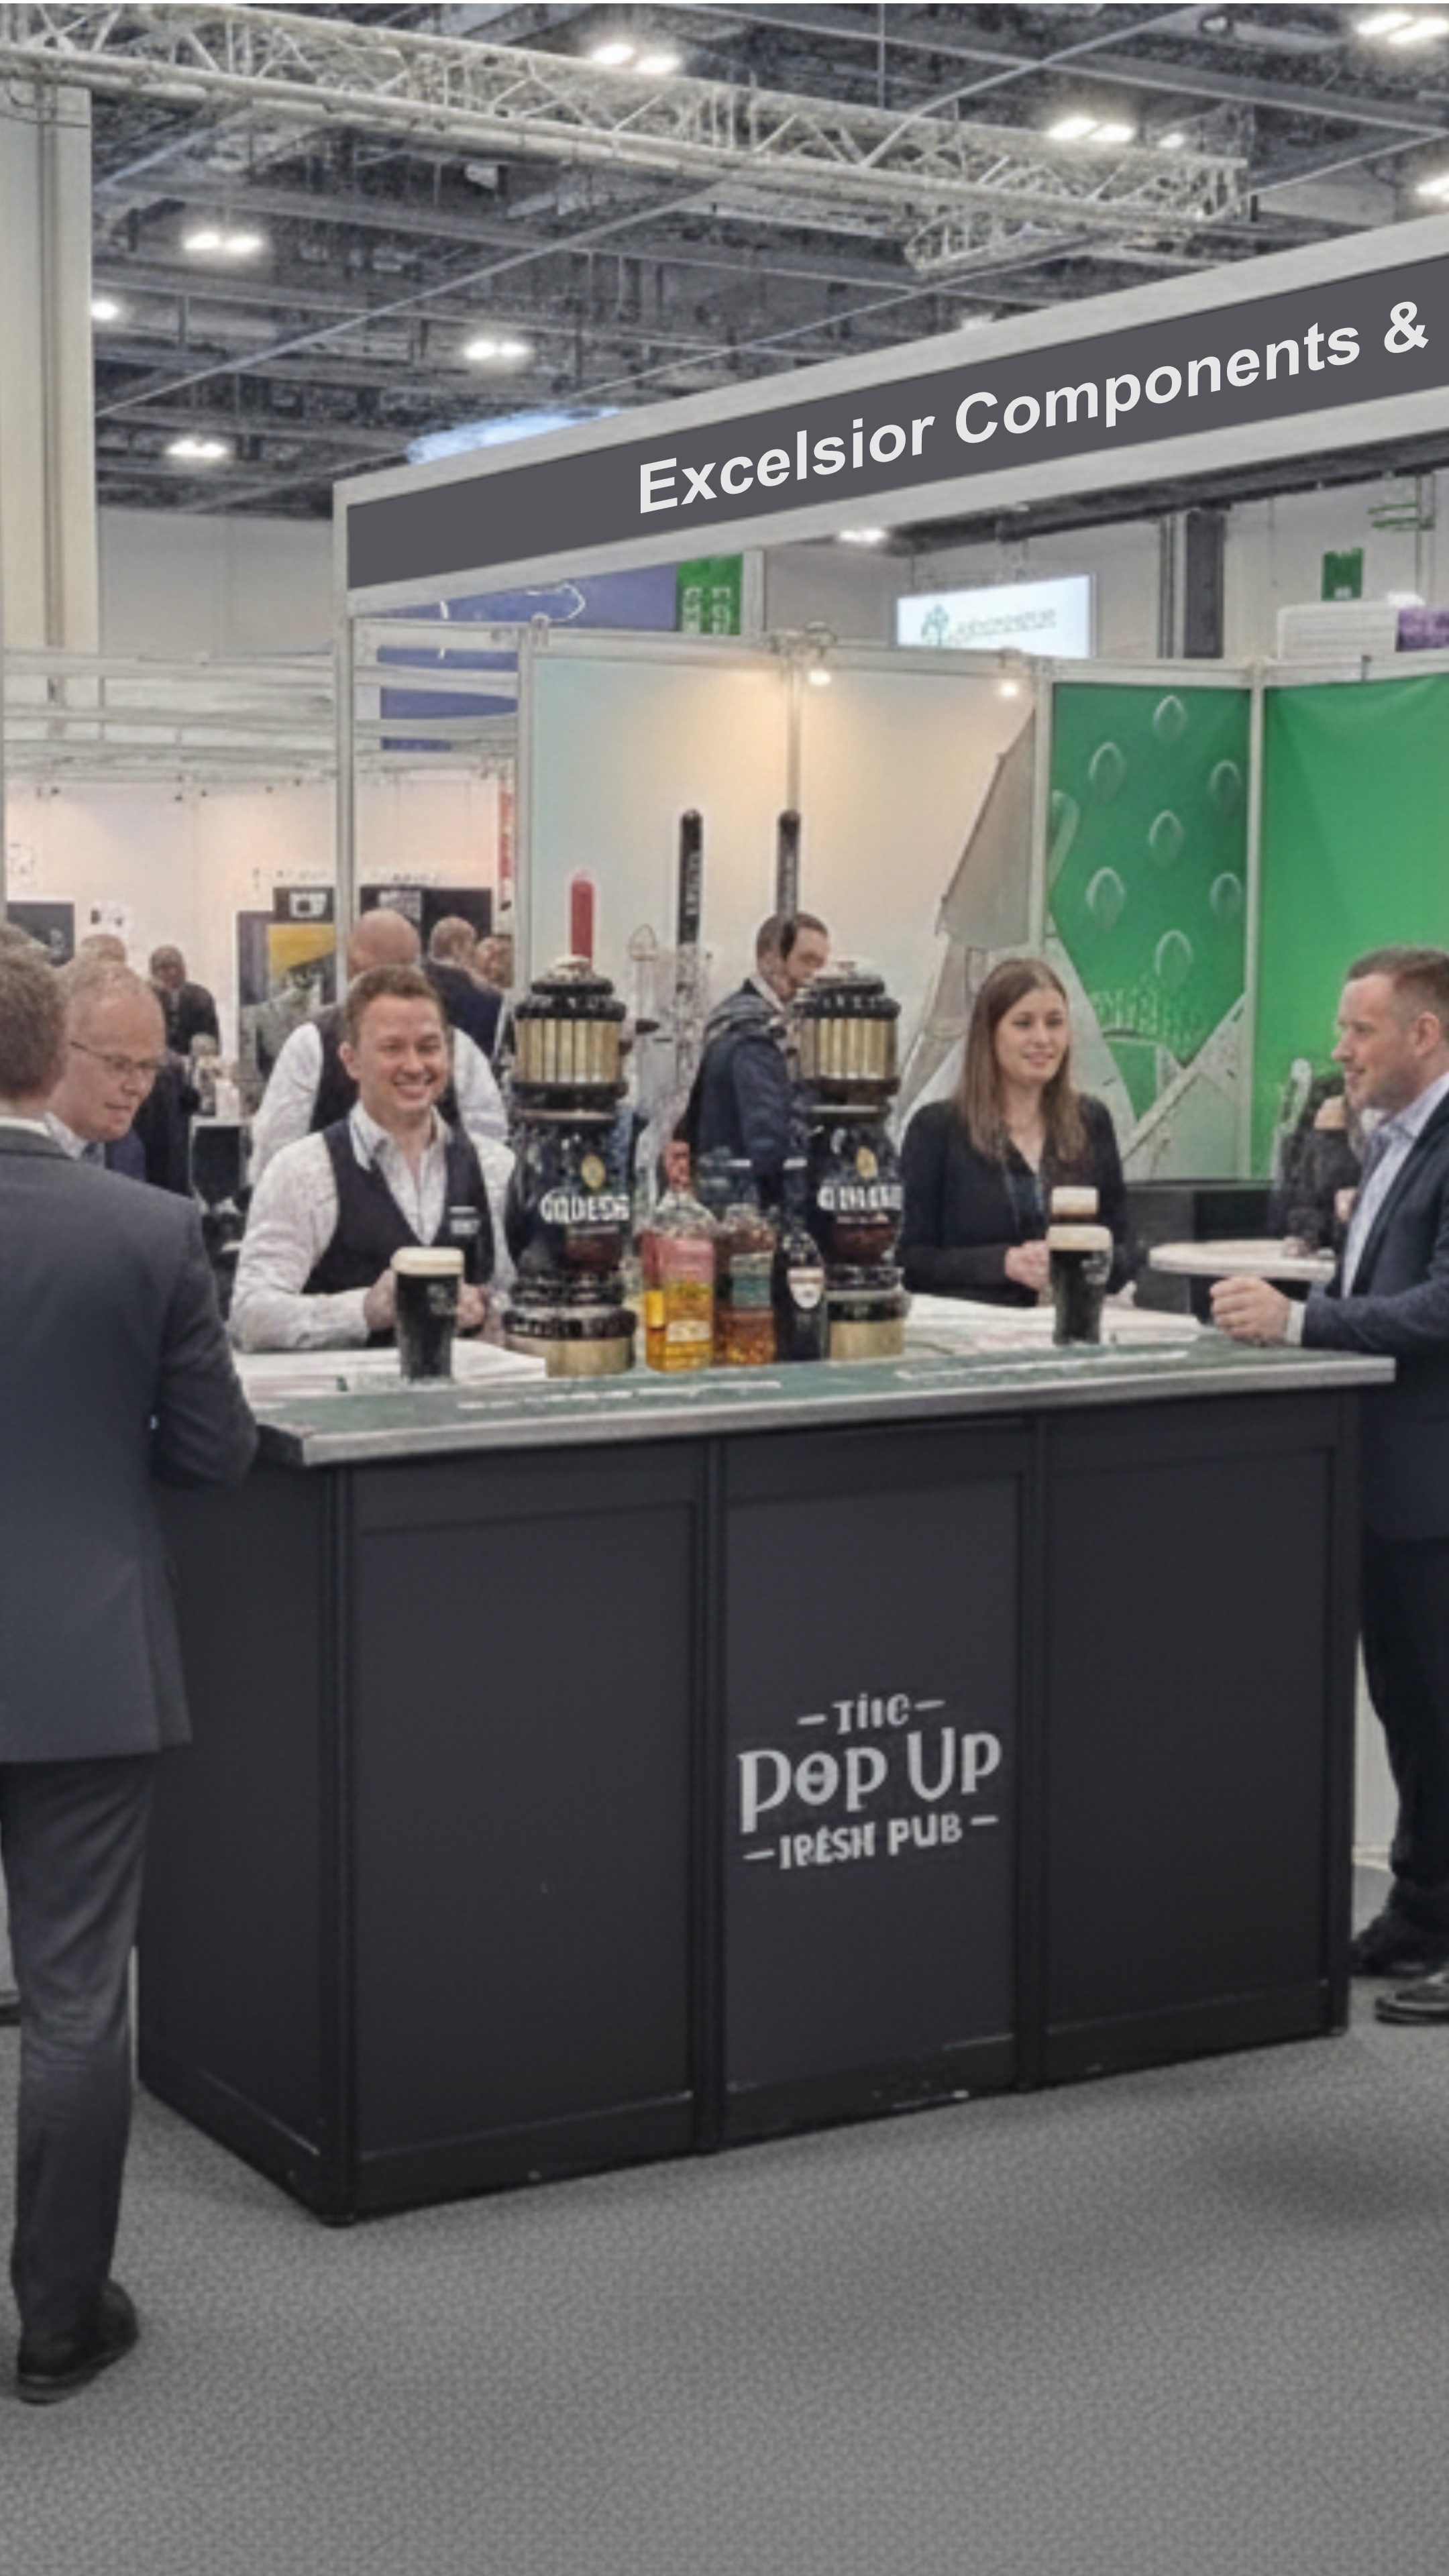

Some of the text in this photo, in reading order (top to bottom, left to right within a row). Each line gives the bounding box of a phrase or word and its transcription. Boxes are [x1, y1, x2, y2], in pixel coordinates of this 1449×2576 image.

[639, 301, 1429, 514] Excelsior Components &
[888, 1813, 963, 1856] PUB
